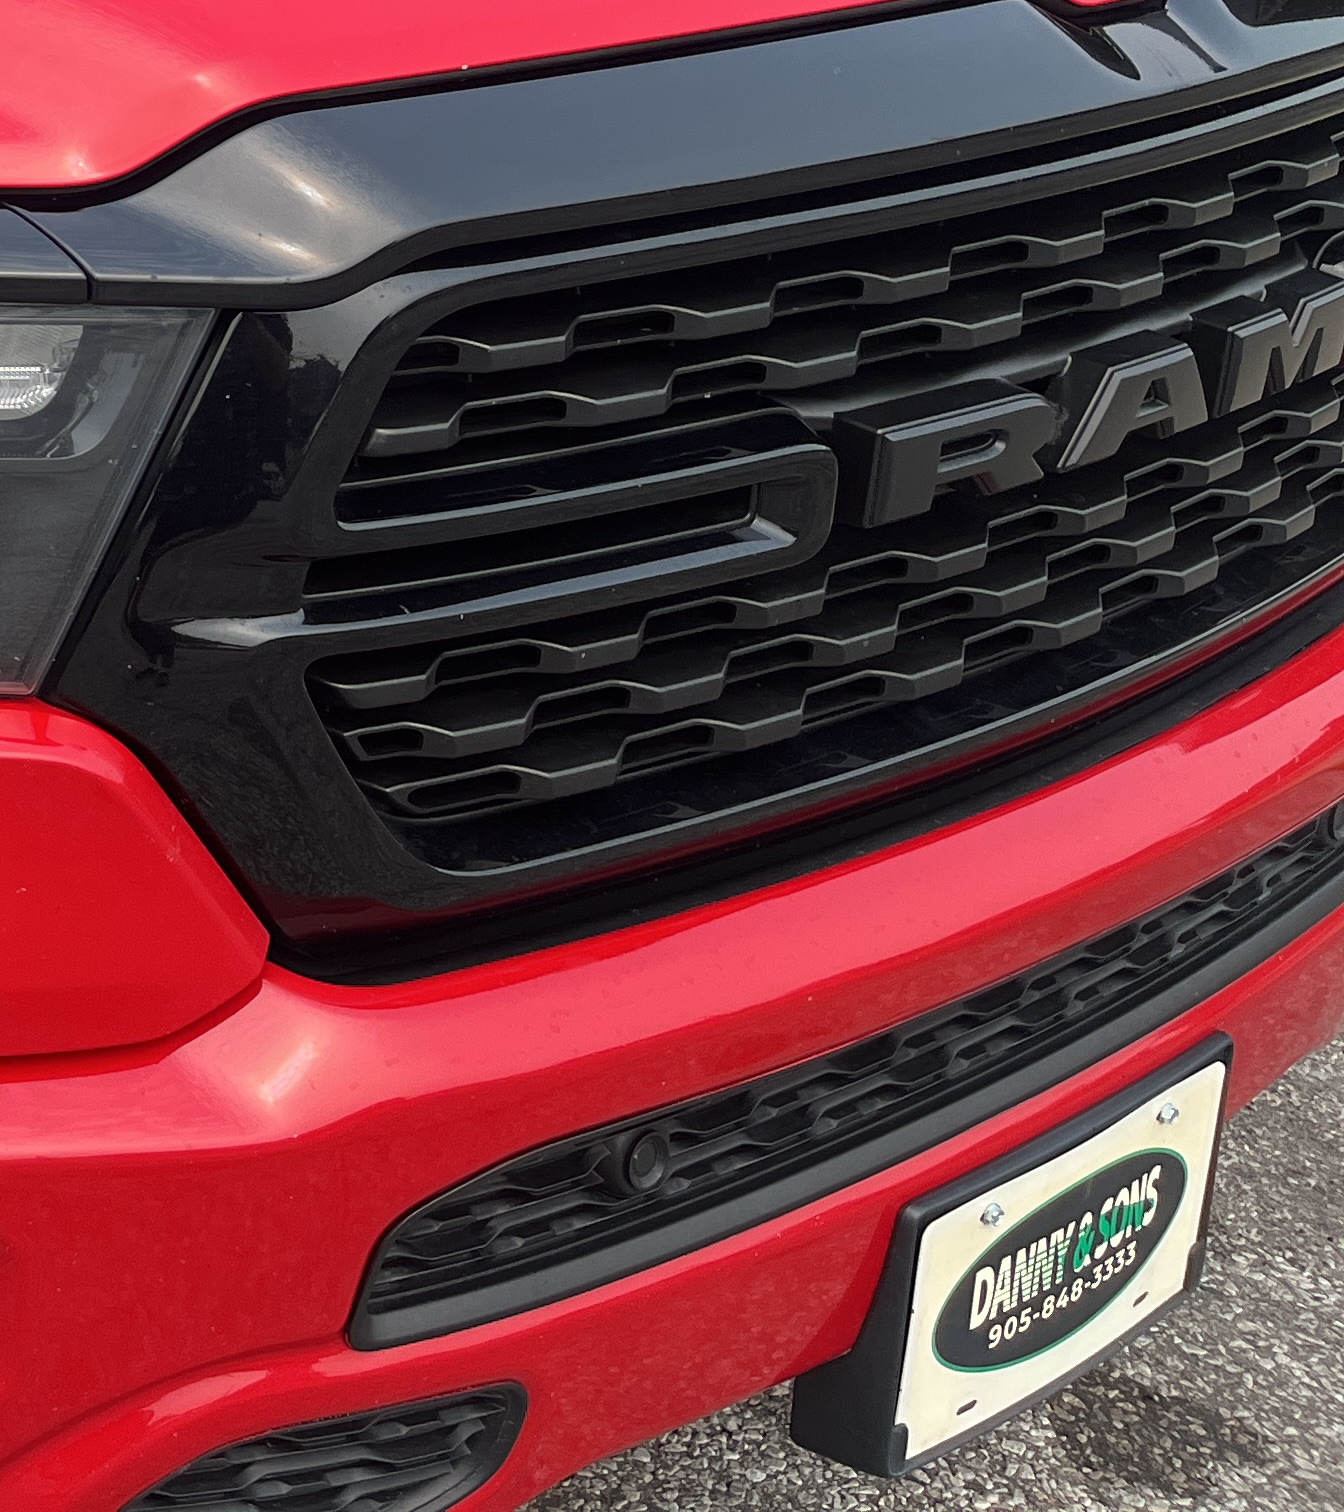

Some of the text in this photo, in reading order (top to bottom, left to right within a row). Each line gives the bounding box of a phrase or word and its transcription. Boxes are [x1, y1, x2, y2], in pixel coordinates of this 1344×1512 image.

[862, 281, 1344, 529] RAM
[968, 1164, 1163, 1331] DANNY & SONS
[988, 1241, 1137, 1350] 905-848-3333
